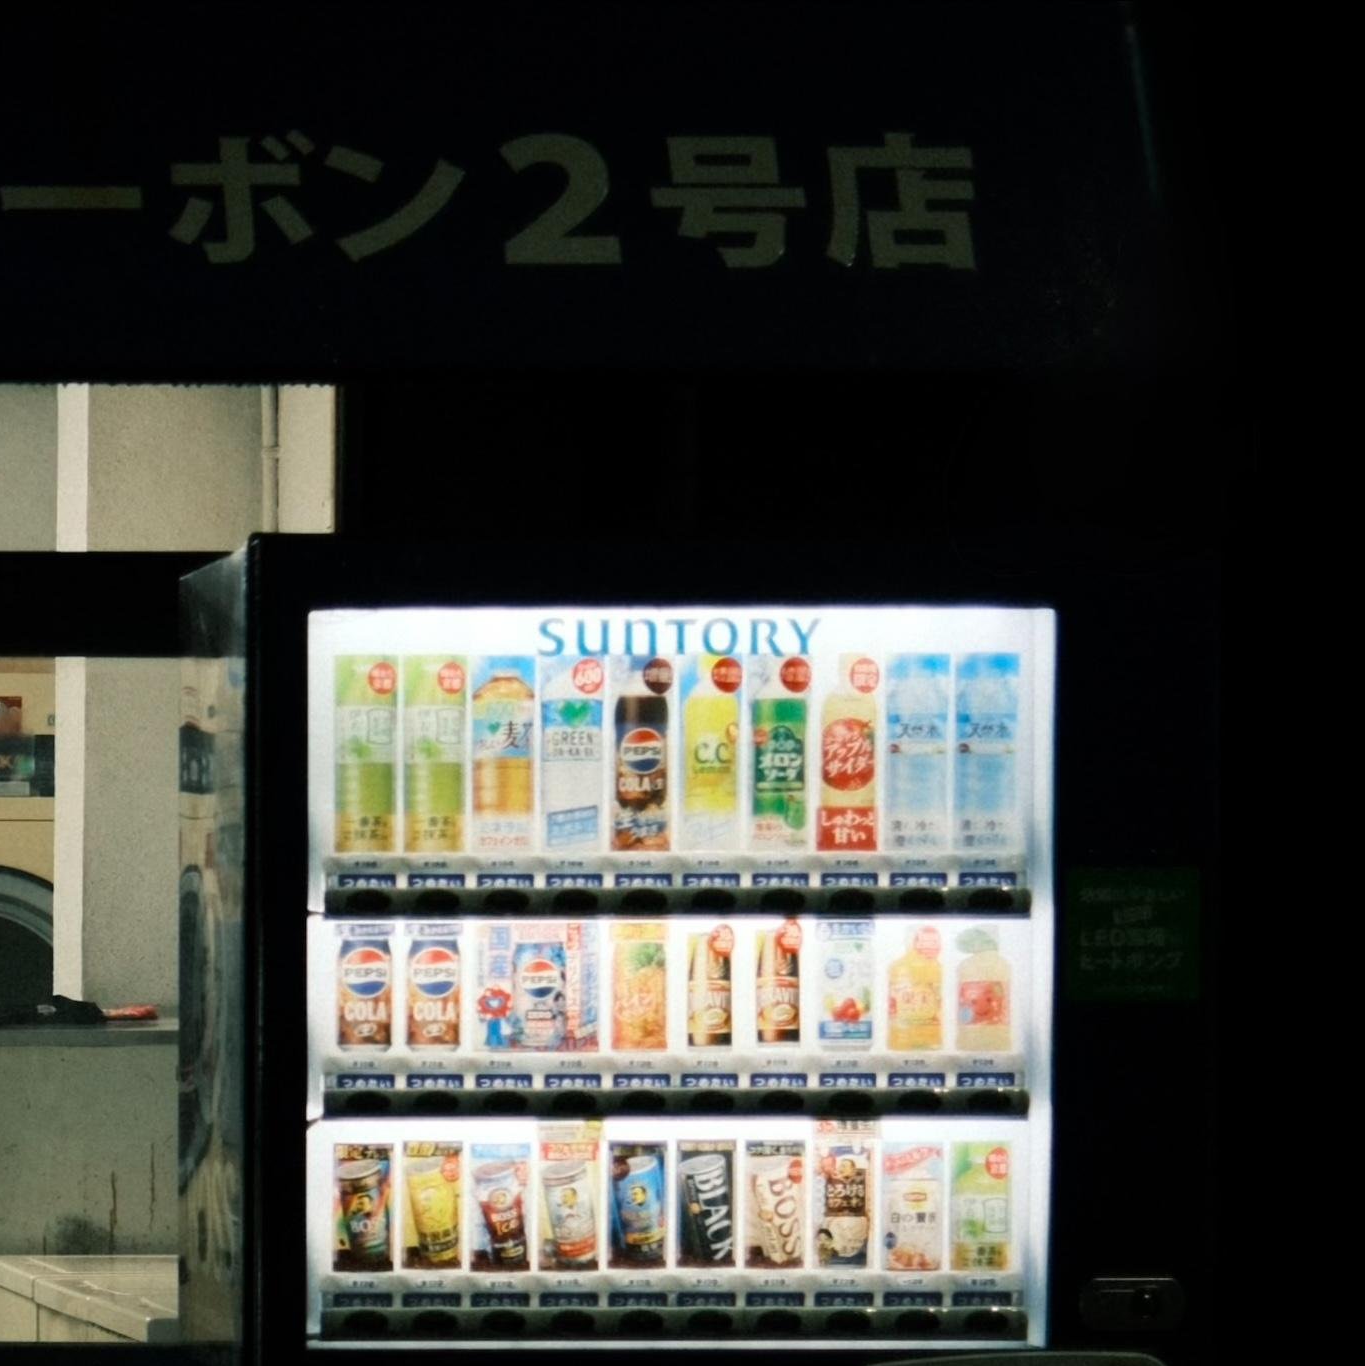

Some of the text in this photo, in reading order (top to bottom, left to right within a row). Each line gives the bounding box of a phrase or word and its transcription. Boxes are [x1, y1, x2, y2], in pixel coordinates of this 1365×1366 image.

[537, 617, 822, 657] SUNTORY
[897, 722, 940, 739] 天然水
[967, 722, 1010, 739] 天然水
[757, 752, 803, 769] メロン
[763, 767, 799, 783] ソーダ
[832, 828, 867, 845] 甘い
[343, 968, 388, 979] PEPSI
[413, 968, 457, 979] PEPSI
[343, 1001, 388, 1022] COLA
[412, 1001, 456, 1022] COLA
[693, 1166, 734, 1262] BLACK
[769, 1175, 801, 1258] BOSS
